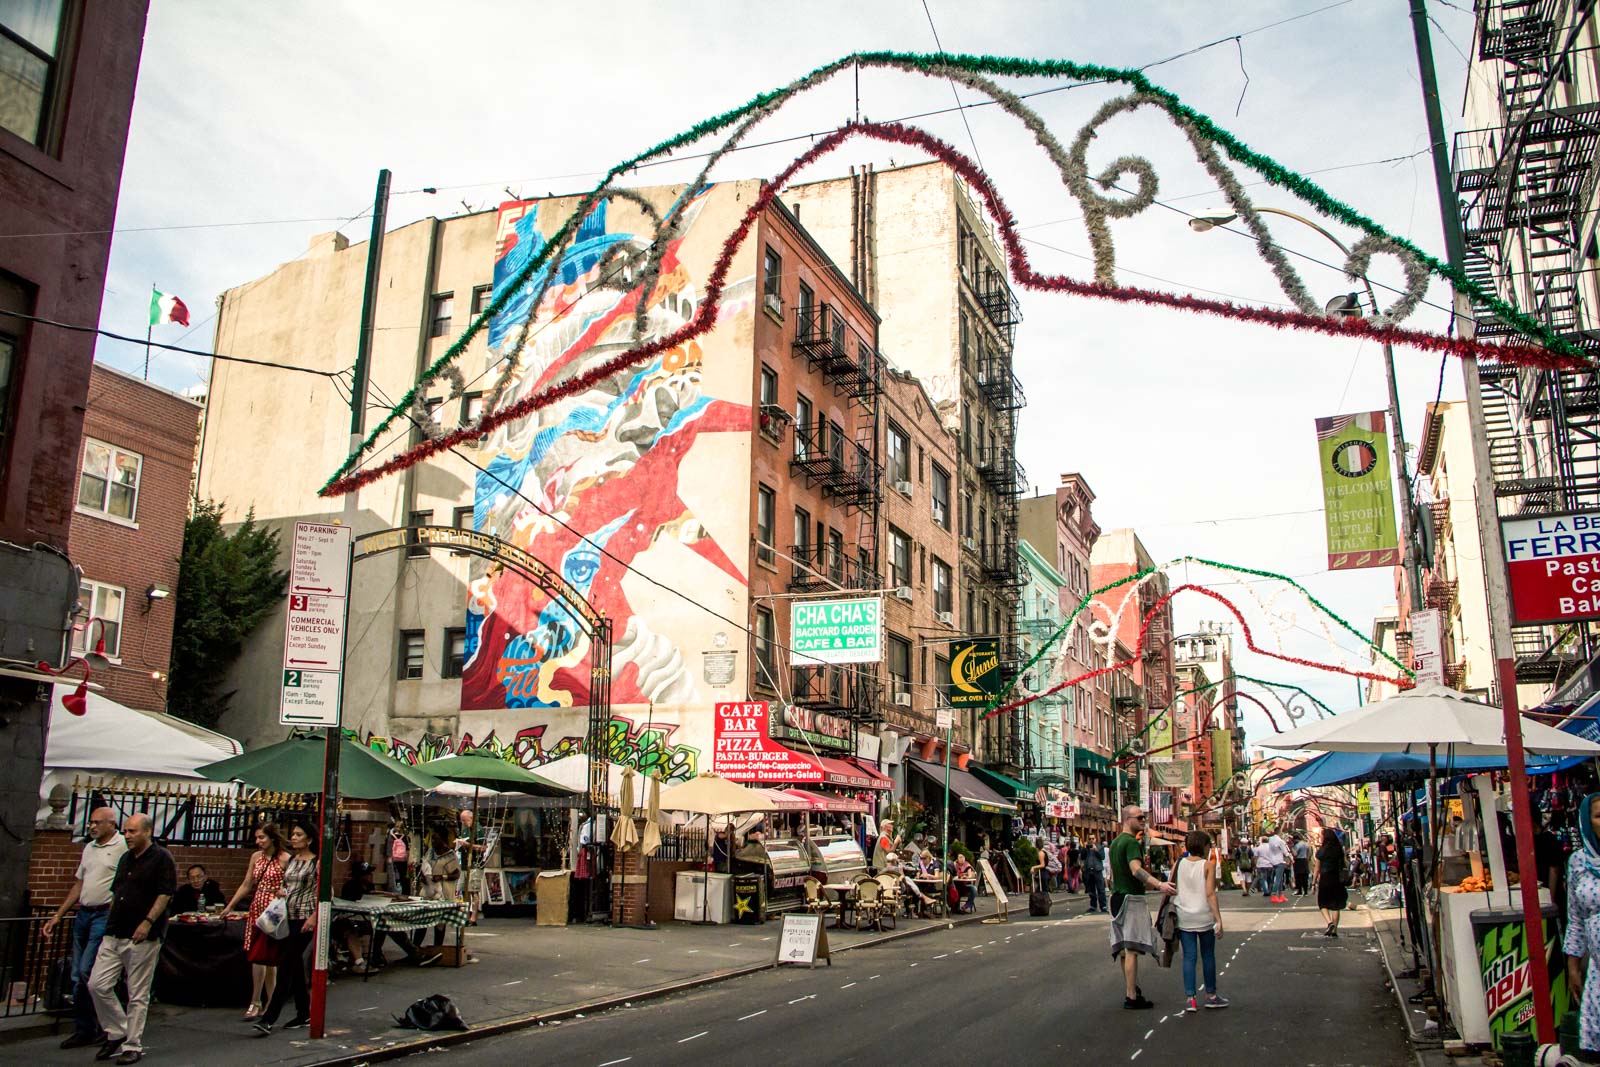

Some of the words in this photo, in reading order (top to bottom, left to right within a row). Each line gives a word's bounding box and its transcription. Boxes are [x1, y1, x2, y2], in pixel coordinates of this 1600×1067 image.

[1327, 480, 1388, 496] WELCOME
[1328, 500, 1342, 509] TO
[1329, 507, 1387, 523] HISTORIC
[310, 526, 338, 535] PARKING
[1330, 523, 1373, 536] LITTLE
[1538, 520, 1568, 534] LA
[363, 529, 407, 555] MOST
[417, 527, 491, 551] PRECIOUS
[1331, 536, 1367, 550] ITALY
[297, 543, 311, 551] Friday
[296, 557, 316, 565] Saturday
[296, 563, 312, 571] Sunday
[1546, 557, 1600, 577] Past
[1572, 576, 1600, 593] Ca
[294, 596, 303, 609] 3
[796, 606, 828, 626] CHA
[831, 603, 876, 624] CHA'S
[291, 617, 336, 626] COMMERCIAL
[291, 625, 321, 633] VEHICLES
[323, 627, 340, 635] ONLY
[796, 626, 840, 637] BACKYARD
[841, 624, 876, 636] GARDEN
[308, 643, 326, 651] Sunday
[796, 638, 831, 650] CAFE
[833, 637, 844, 648] &
[846, 636, 876, 647] BAR
[965, 655, 999, 682] Luna
[288, 671, 298, 686] 2
[305, 699, 324, 707] Sunday
[719, 704, 763, 717] CAFE
[724, 718, 757, 731] BAR
[768, 704, 777, 736] CAFE
[789, 705, 815, 732] CHA
[717, 738, 764, 751] PIZZA
[716, 752, 788, 761] PASTA-BURGER
[715, 762, 811, 770] Espresso-Coffee-Cappuccino
[758, 770, 822, 779] Desserts-Gelato
